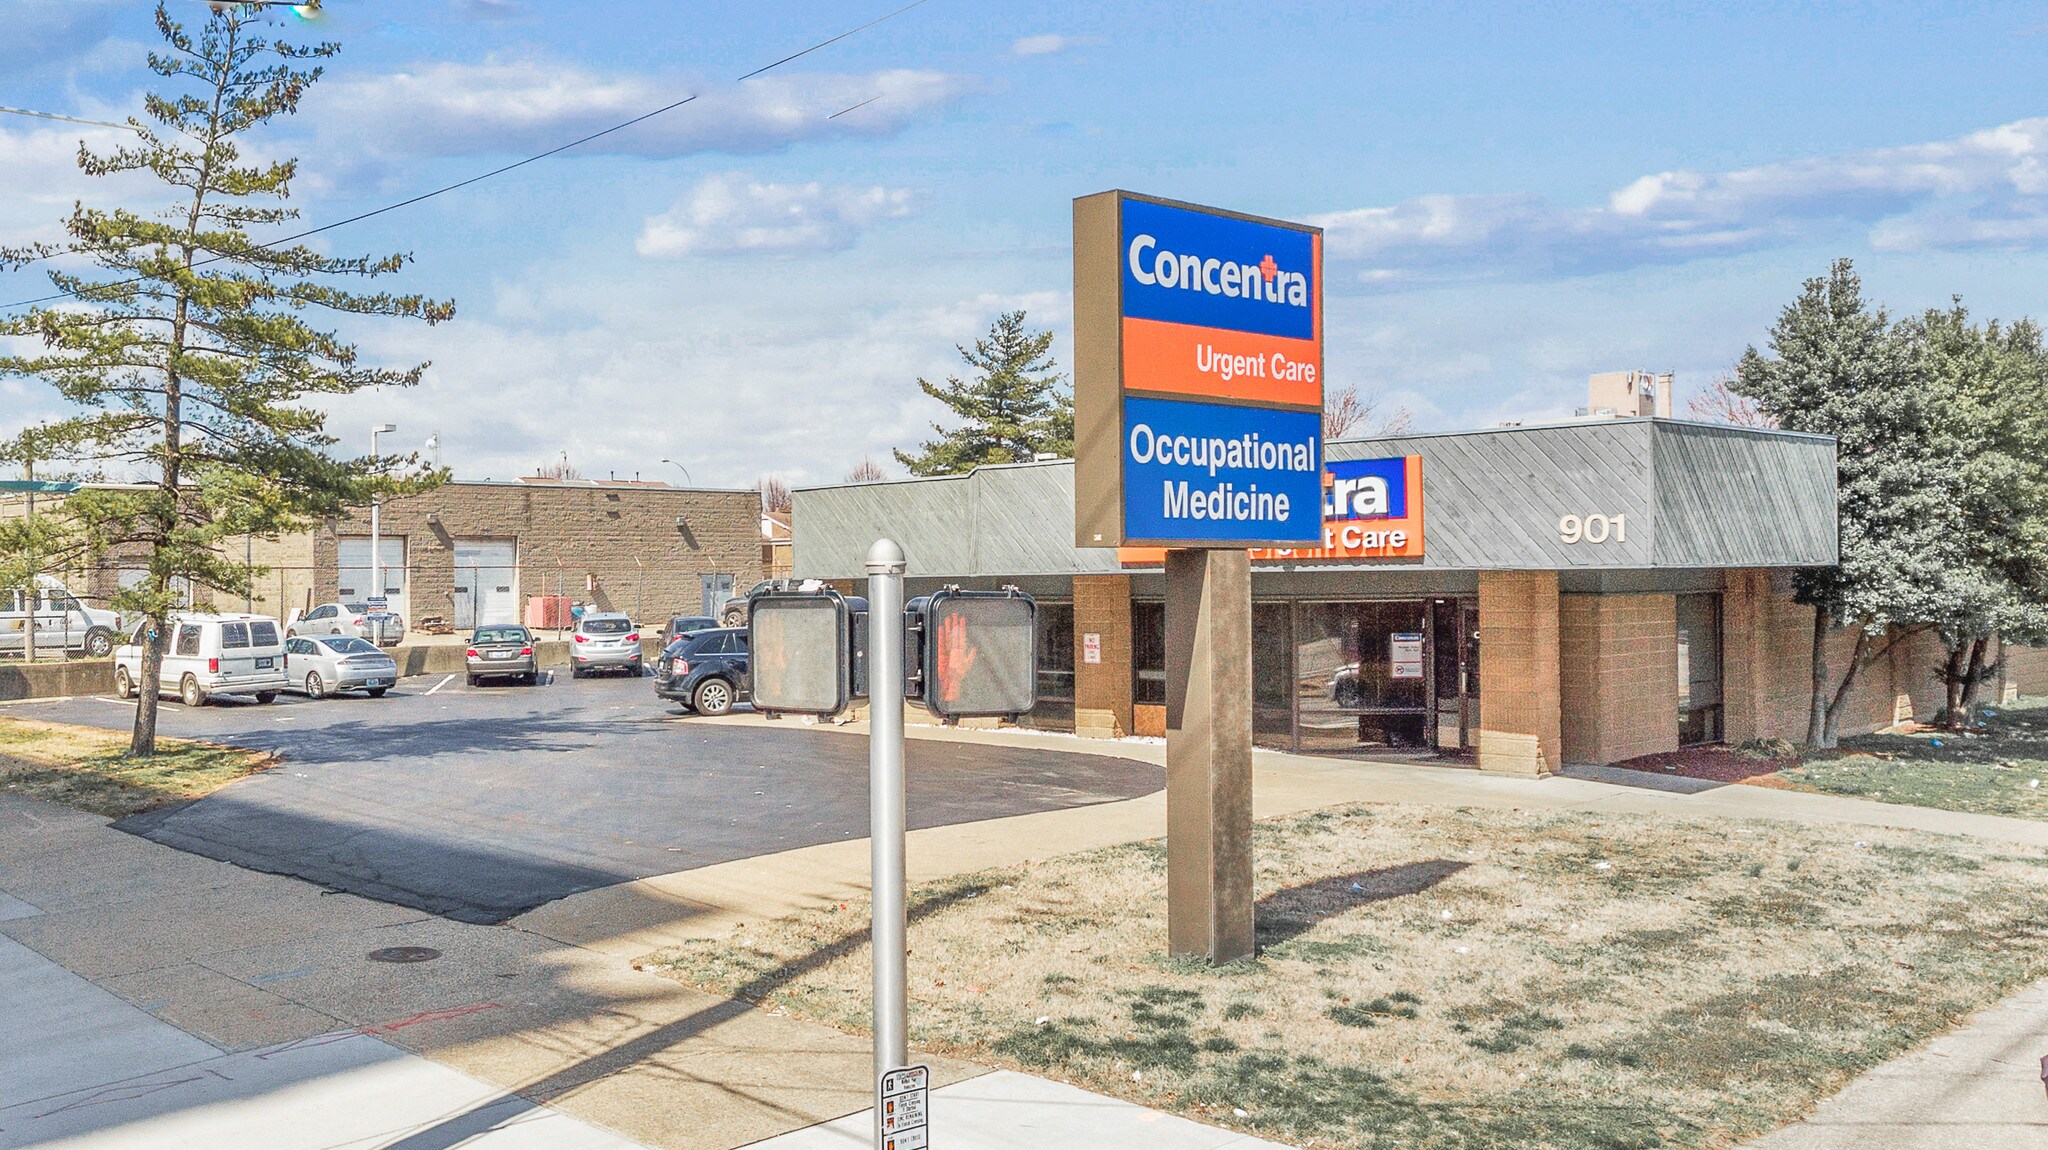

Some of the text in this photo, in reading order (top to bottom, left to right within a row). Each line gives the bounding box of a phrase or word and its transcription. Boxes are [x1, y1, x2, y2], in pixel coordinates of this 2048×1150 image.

[1128, 233, 1308, 308] Concentra
[1196, 343, 1317, 384] Urgent Care
[1129, 423, 1316, 477] Occupational
[1162, 480, 1291, 522] Medicine
[1341, 525, 1408, 550] Care
[1559, 513, 1627, 545] 901
